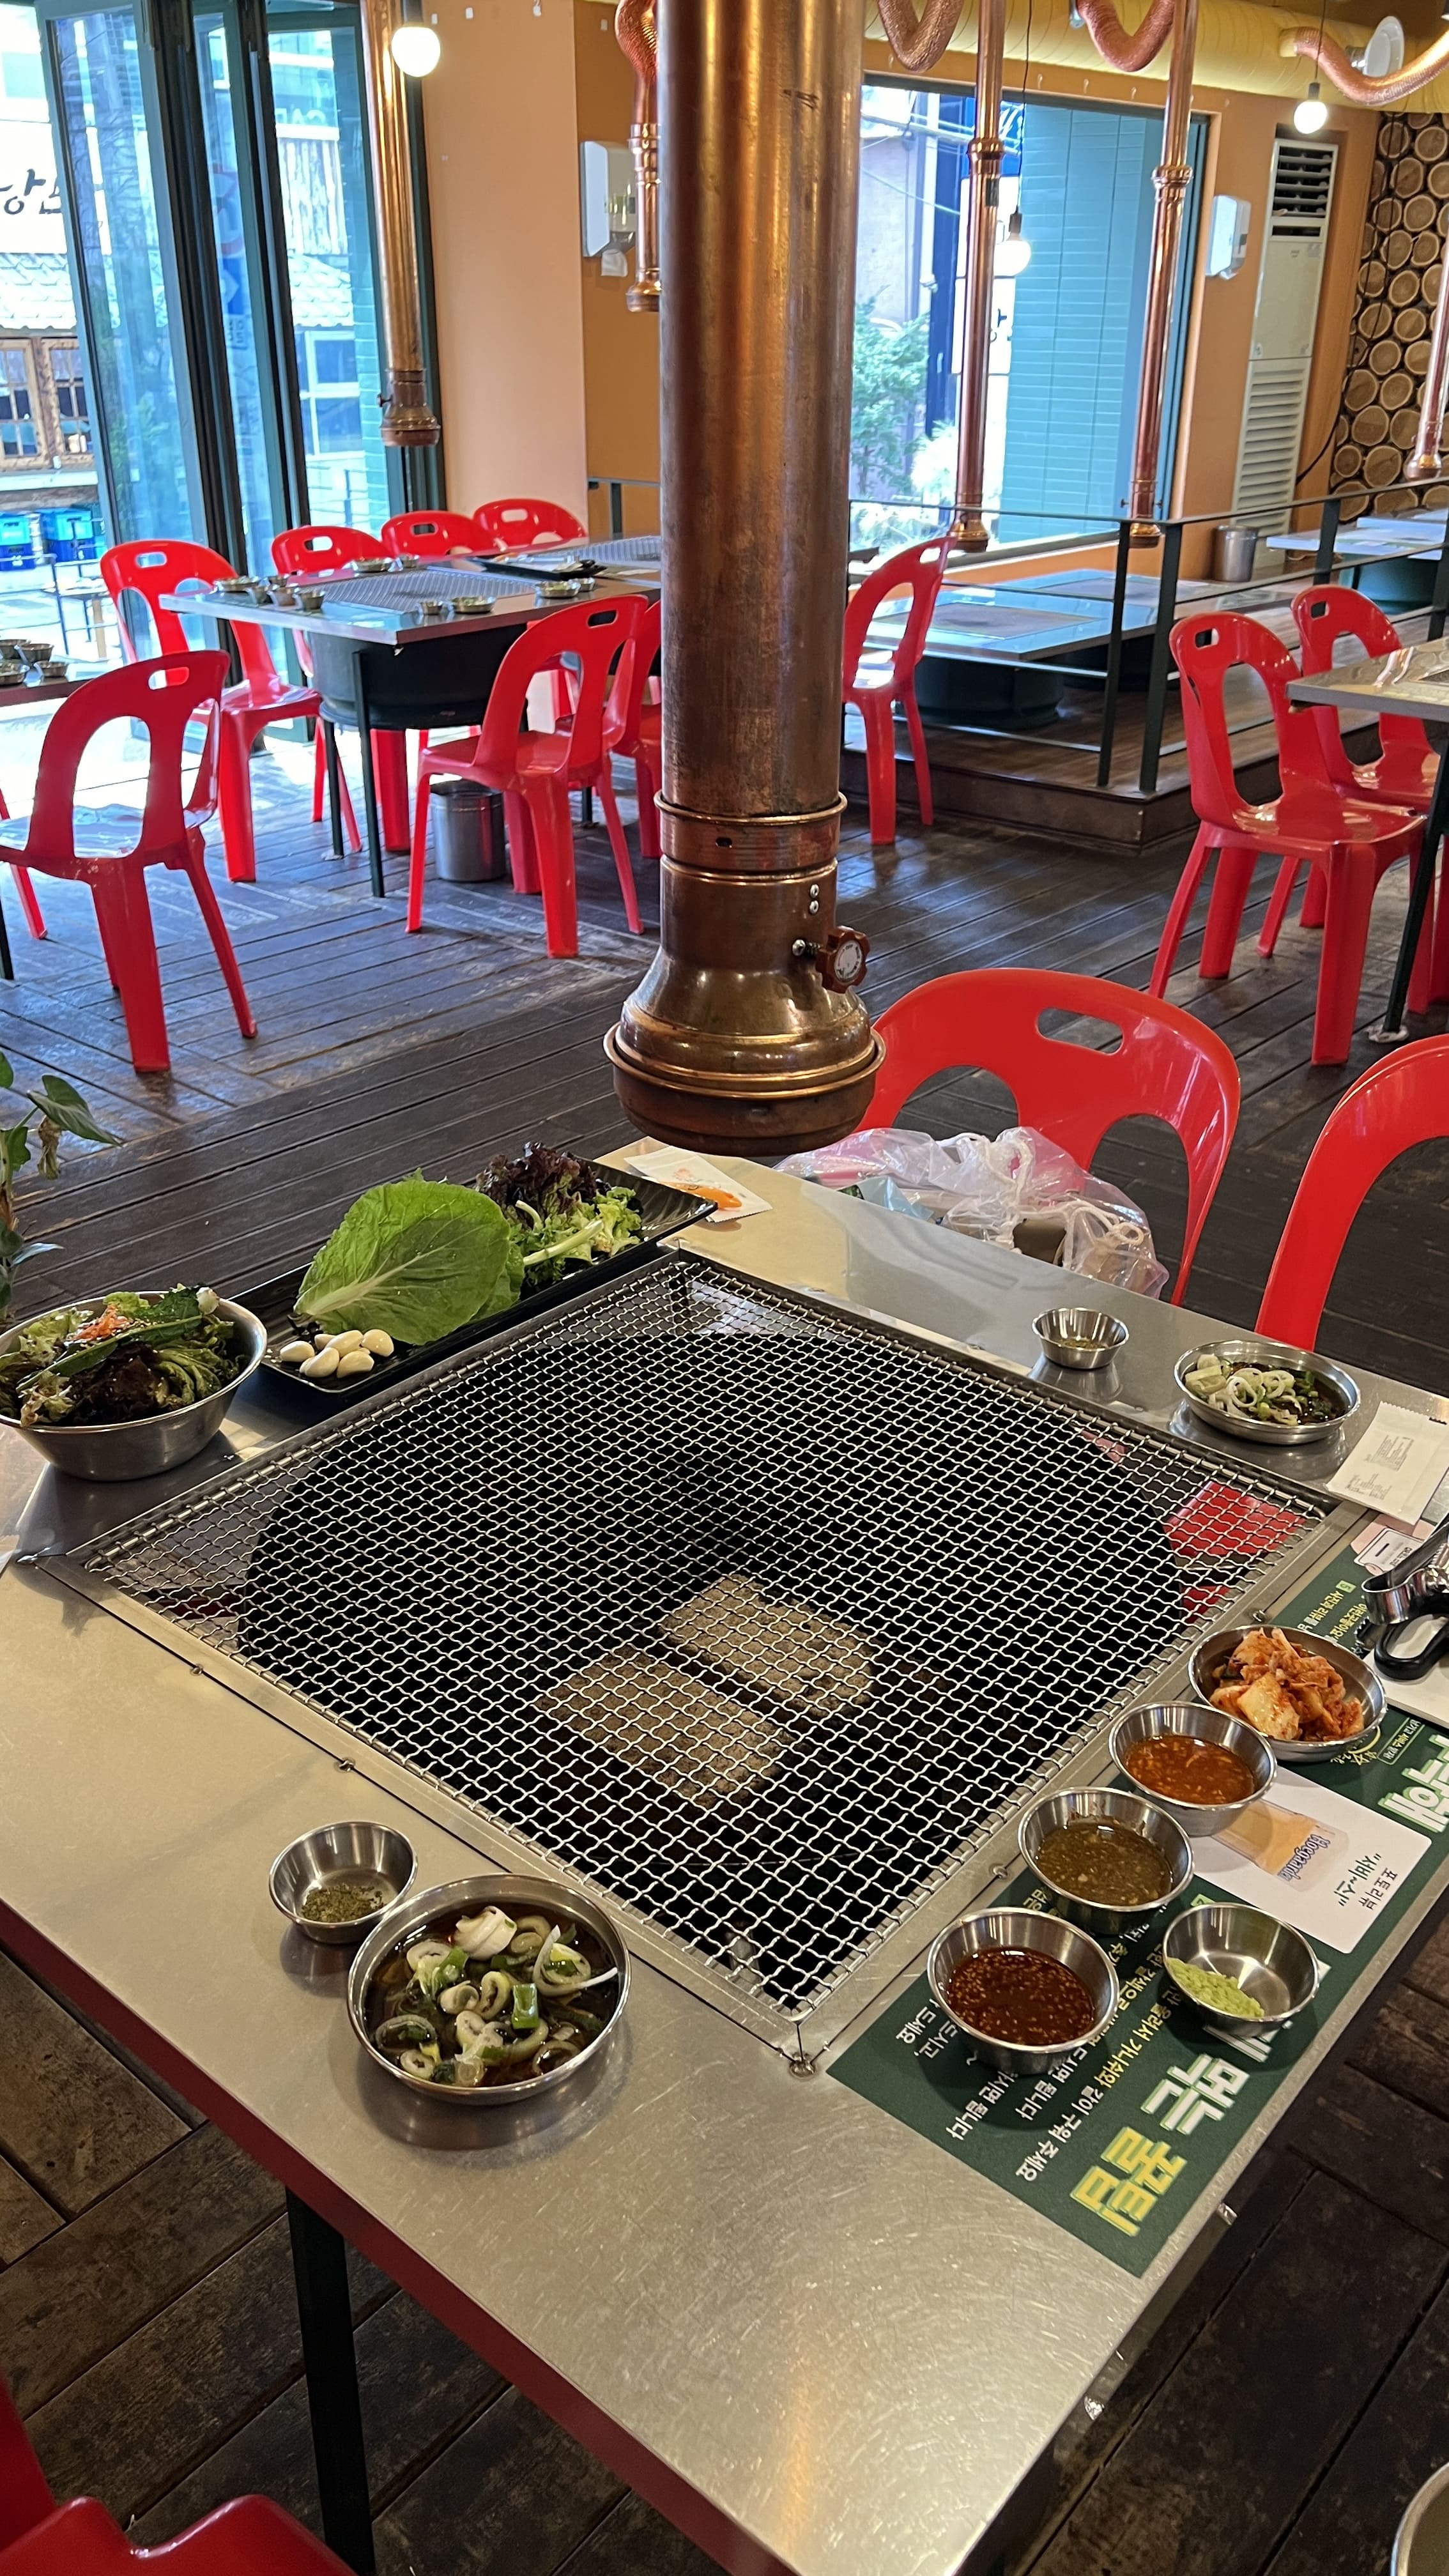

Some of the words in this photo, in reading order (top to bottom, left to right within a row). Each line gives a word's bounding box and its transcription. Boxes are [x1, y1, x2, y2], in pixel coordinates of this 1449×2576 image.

[1320, 1590, 1344, 1611] 사진과
[1359, 1867, 1398, 1910] 포토리뷰
[896, 2007, 936, 2044] 드세요
[914, 2021, 958, 2058] 드시고,
[1133, 2004, 1172, 2042] 올려서
[1095, 2039, 1142, 2088] 가니쉬와
[1016, 2081, 1057, 2120] 됩니다
[1071, 2085, 1103, 2115] 같이
[1141, 2053, 1248, 2135] 먹는
[946, 2101, 988, 2140] 됩니다
[1048, 2114, 1082, 2143] 구워
[1016, 2140, 1059, 2181] 주세요
[1071, 2128, 1187, 2235] 꿀팁
